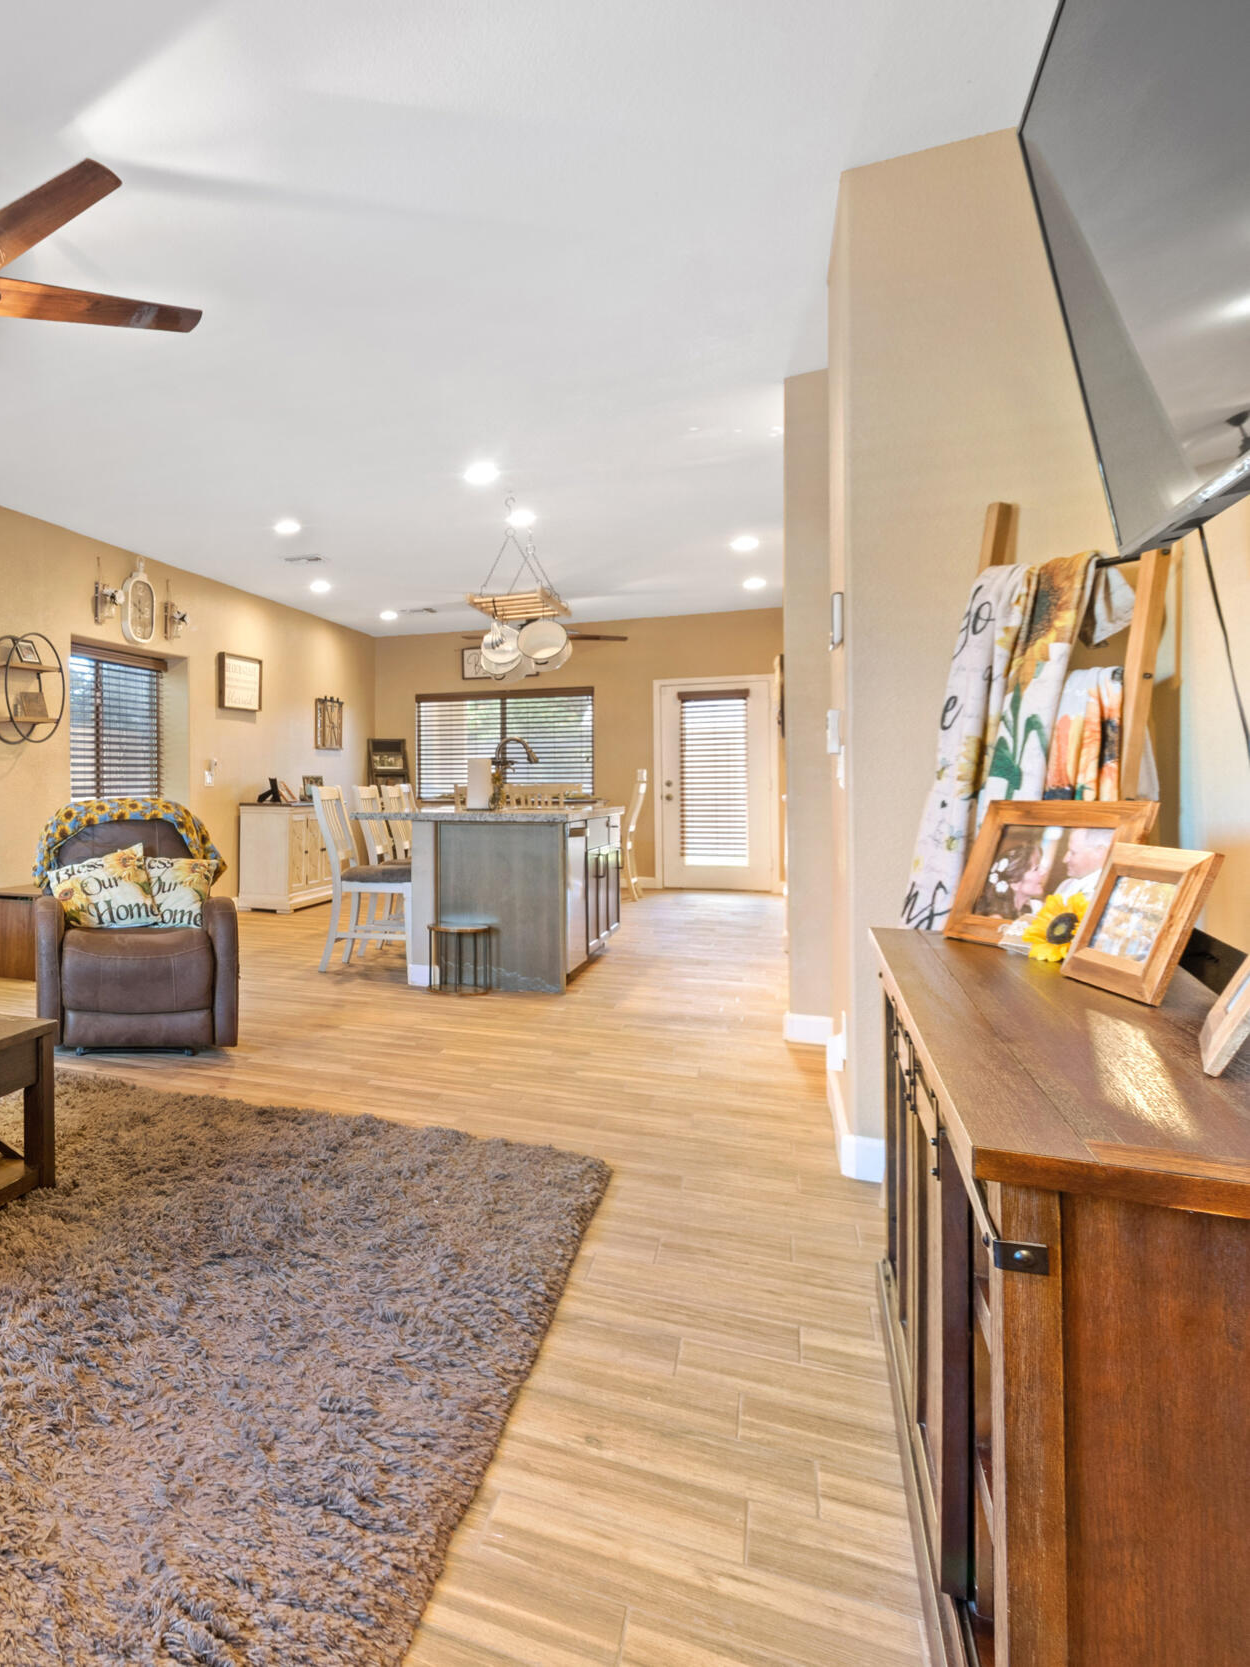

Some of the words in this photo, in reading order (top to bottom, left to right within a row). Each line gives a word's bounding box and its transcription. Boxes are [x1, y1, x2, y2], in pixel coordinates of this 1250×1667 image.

[80, 875, 123, 897] Our
[88, 899, 159, 925] Home
[160, 908, 203, 928] ome
